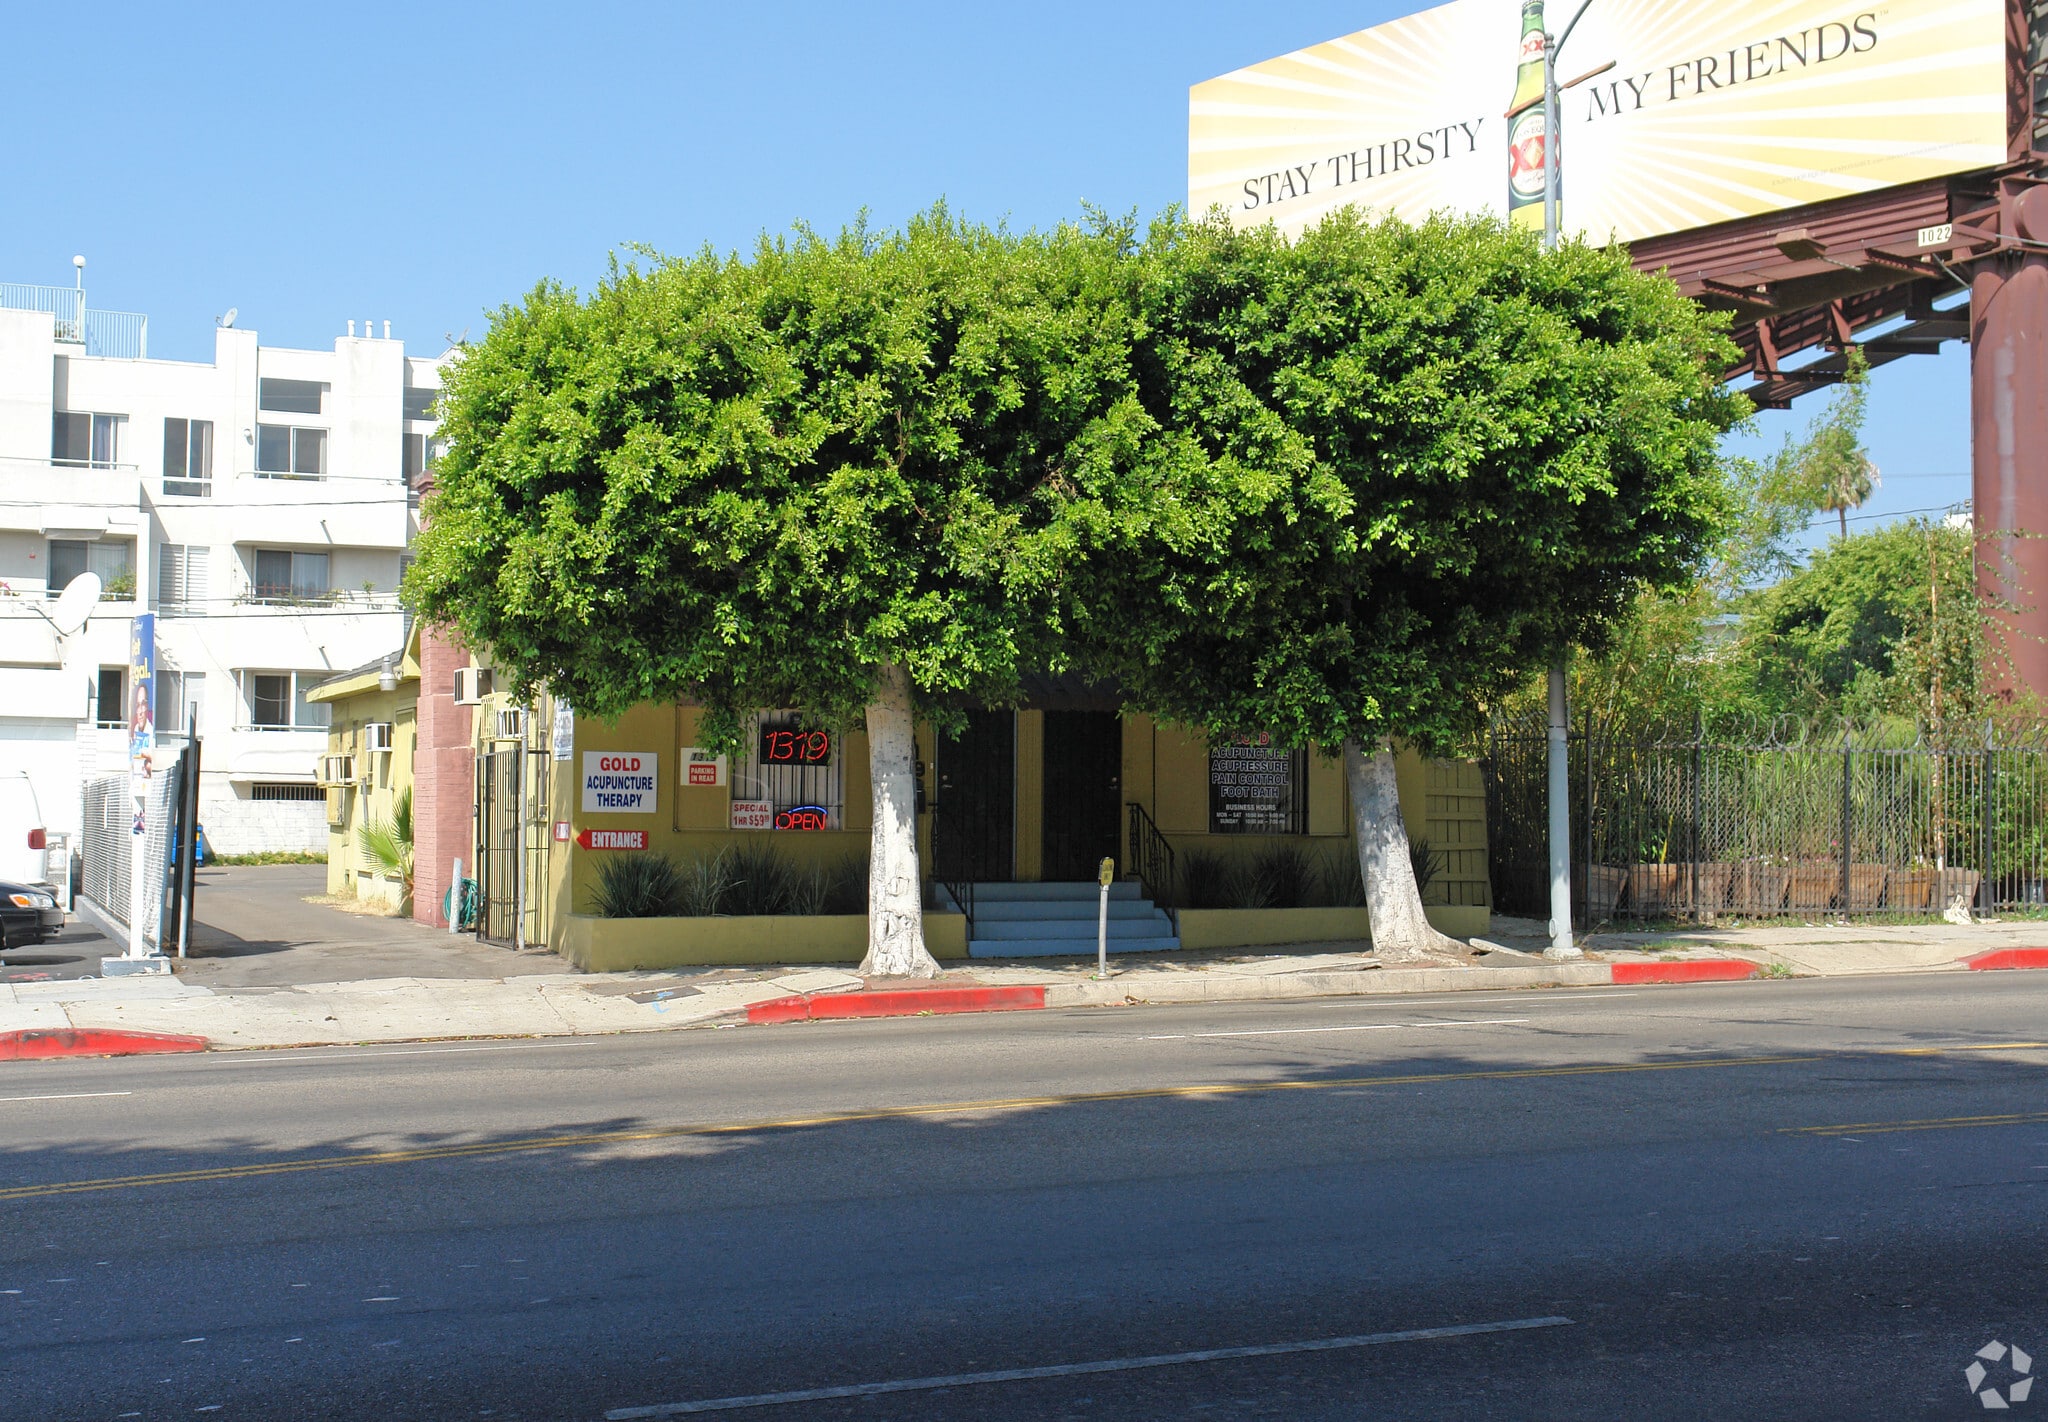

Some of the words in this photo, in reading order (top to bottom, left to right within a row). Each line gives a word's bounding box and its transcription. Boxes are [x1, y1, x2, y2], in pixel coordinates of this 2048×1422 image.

[1243, 162, 1318, 209] STAY
[1327, 117, 1485, 187] THIRSTY
[1585, 72, 1653, 122] MY
[1665, 13, 1878, 101] FRIENDS
[1922, 226, 1951, 244] 1022
[765, 731, 828, 760] 1319
[600, 757, 641, 772] GOLD
[691, 767, 714, 775] PARKING
[1211, 760, 1288, 772] ACUPRESSURE
[587, 775, 654, 790] ACUPUNCTURE
[1211, 772, 1236, 785] PAIN
[1238, 772, 1289, 785] CONTROL
[1220, 785, 1250, 798] FOOT
[1251, 786, 1280, 798] BATH
[597, 793, 643, 808] THERAPY
[733, 803, 769, 813] SPECIAL
[1225, 803, 1255, 811] BUSINESS
[776, 812, 828, 830] OPEN
[591, 831, 643, 848] ENTRANCE
